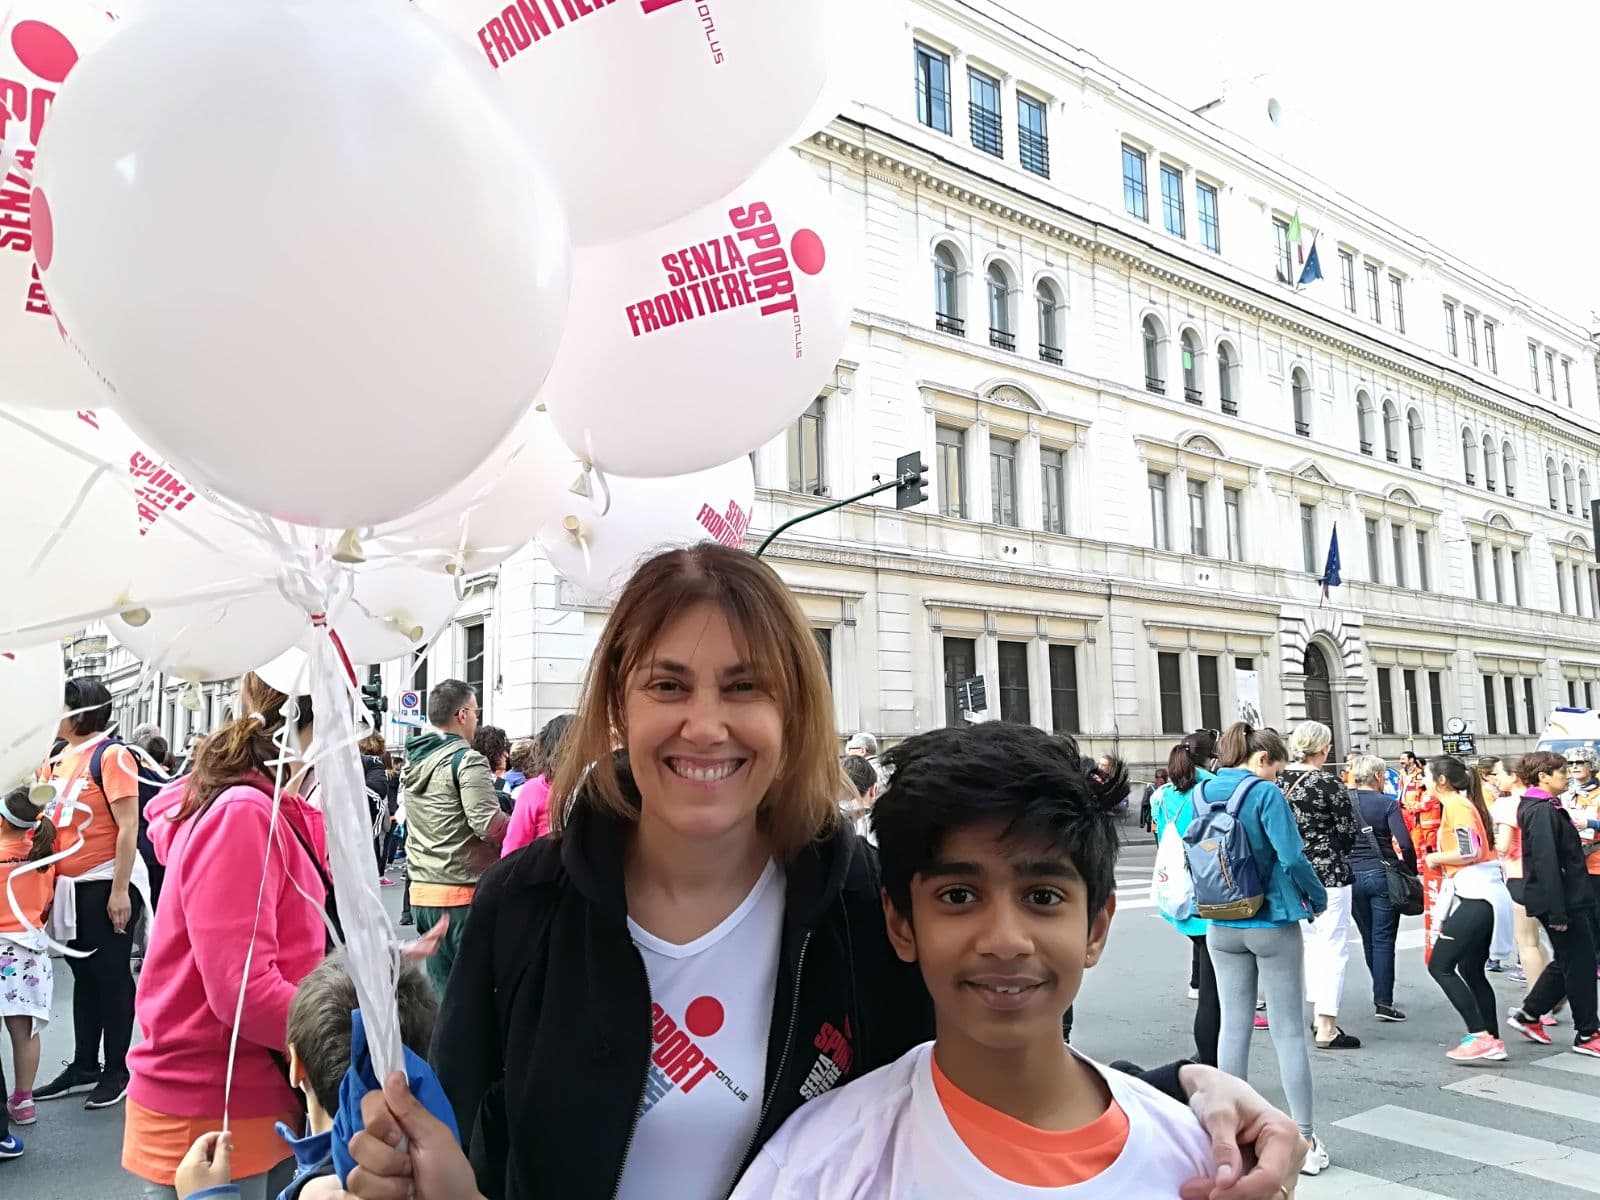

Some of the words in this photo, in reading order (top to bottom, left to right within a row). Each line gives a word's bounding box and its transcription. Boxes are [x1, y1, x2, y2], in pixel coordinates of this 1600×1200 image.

[661, 234, 746, 288] SENZA
[729, 201, 799, 317] SPORT
[625, 269, 757, 337] FRONTIERE
[799, 1053, 834, 1101] SENZA
